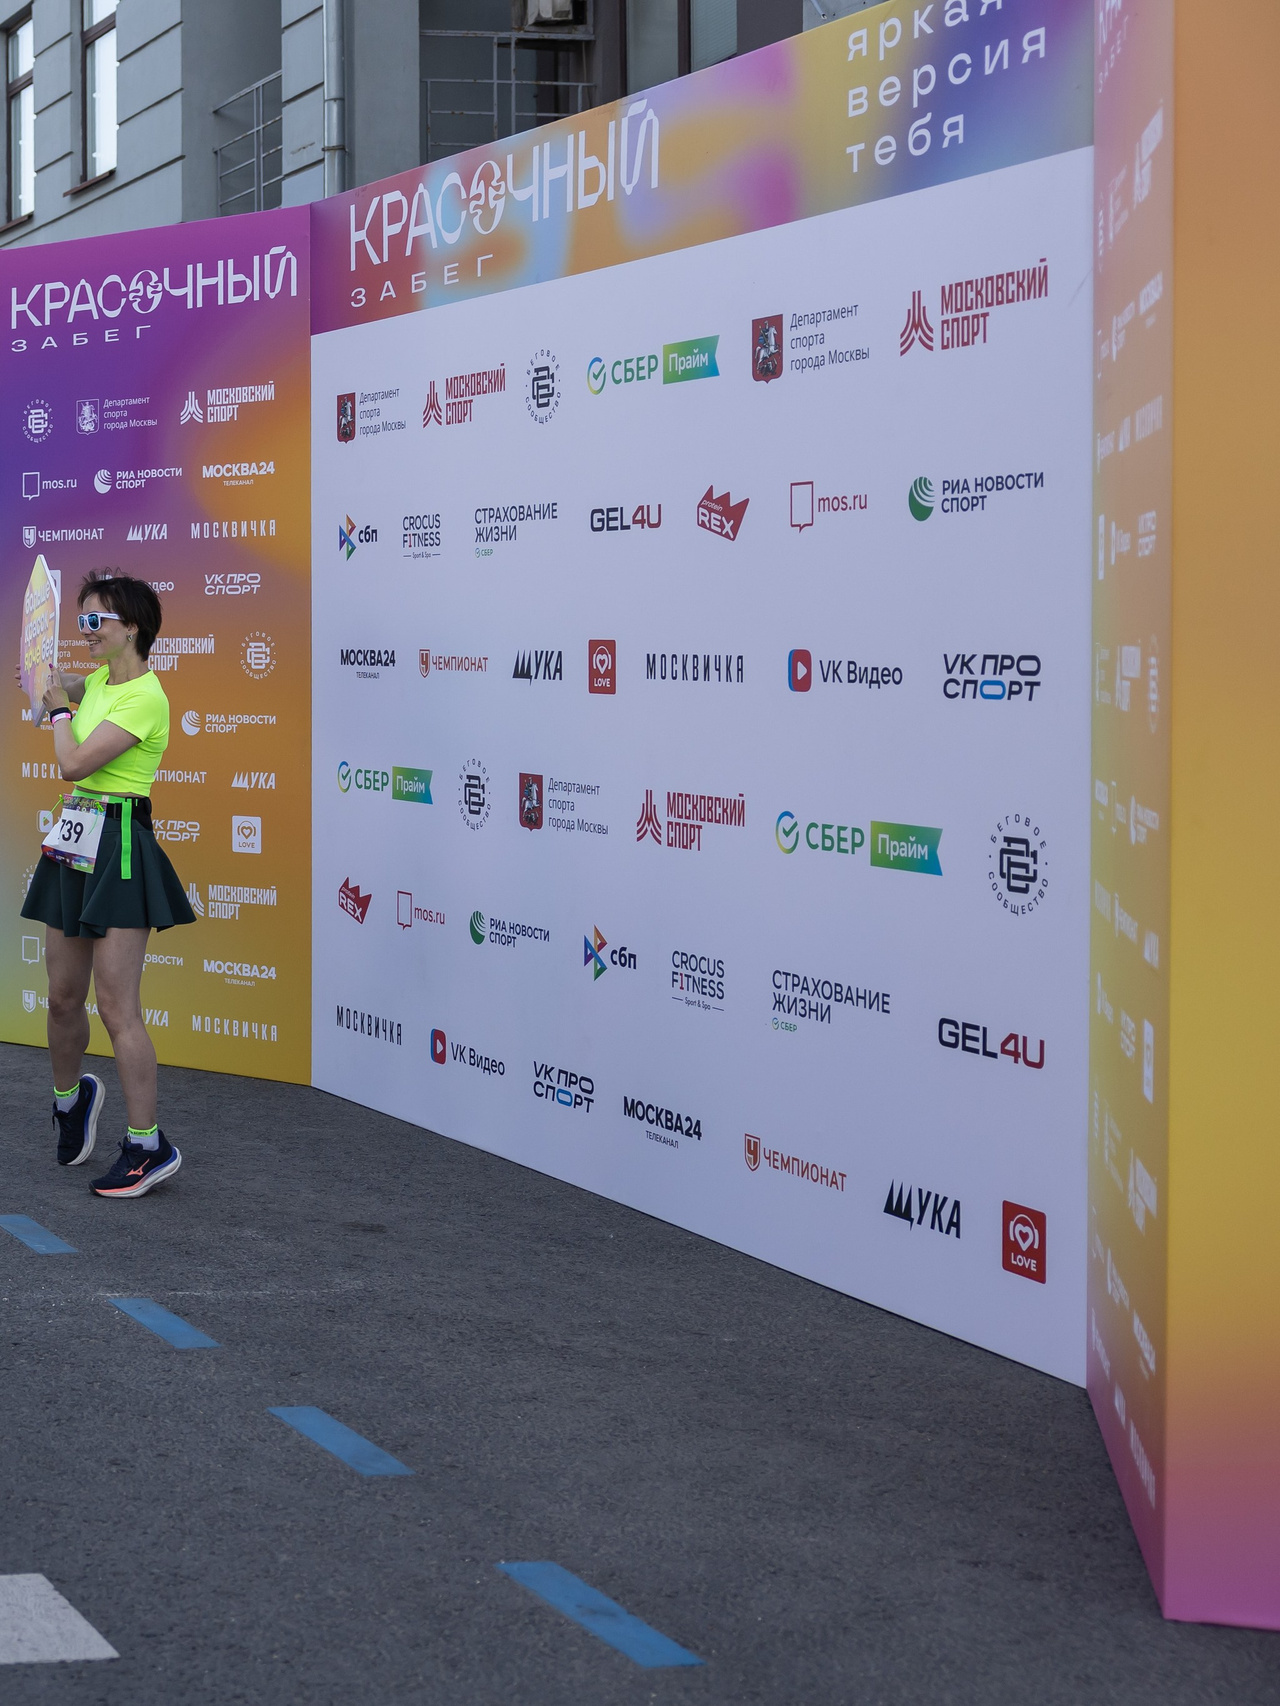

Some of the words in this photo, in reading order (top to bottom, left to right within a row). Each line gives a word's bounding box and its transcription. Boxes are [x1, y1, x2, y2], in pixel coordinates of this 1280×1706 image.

[847, 27, 1047, 118] версия
[845, 113, 965, 173] тебя
[350, 99, 659, 271] КРАСОЧНЫЙ
[11, 246, 297, 329] КРАСОЧНЫЙ
[351, 253, 493, 308] ЗАБЕГ
[941, 257, 1048, 316] МОСКОВСКИЙ
[790, 304, 859, 331] Департамент
[11, 325, 151, 352] ЗАБЕГ
[790, 331, 825, 351] спорта
[941, 312, 990, 350] СПОРТ
[526, 349, 560, 375] БЕГОВОЕ
[611, 354, 658, 385] СБЕР
[668, 349, 709, 376] Прайм
[790, 355, 825, 373] города
[828, 347, 870, 365] Москвы
[445, 363, 506, 397] МОСКОВСКИЙ
[103, 396, 150, 409] Департамент
[207, 380, 275, 406] МОСКОВСКИЙ
[359, 387, 400, 406] Департамент
[23, 399, 53, 419] БЕГОВОЕ
[103, 410, 128, 421] спорта
[207, 405, 239, 423] СПОРТ
[359, 406, 381, 420] спорта
[445, 399, 474, 426] СПОРТ
[525, 391, 562, 425] СООБЩЕСТВО
[22, 424, 54, 443] СООБЩЕСТВО
[103, 421, 127, 431] города
[129, 418, 158, 428] Москвы
[359, 423, 380, 437] города
[381, 419, 407, 432] Москвы
[116, 470, 135, 479] РИА
[137, 467, 182, 478] НОВОСТИ
[202, 461, 275, 478] МОСКВА24
[42, 478, 77, 489] mos.ru
[116, 479, 146, 489] СПОРТ
[942, 478, 970, 495] РИА
[974, 471, 1044, 493] НОВОСТИ
[700, 498, 723, 512] protein
[818, 492, 868, 512] mos.ru
[941, 495, 987, 513] СПОРТ
[402, 513, 441, 531] CROCUS
[474, 502, 558, 524] СТРАХОВАНИЕ
[590, 503, 662, 532] GEL4U
[126, 523, 168, 543] ЩУКА
[191, 519, 276, 539] МОСКВИЧКА
[474, 524, 517, 543] ЖИЗНИ
[698, 510, 734, 537] REX
[38, 528, 104, 542] ЧЕМПИОНАТ
[358, 525, 378, 544] сбп
[481, 548, 493, 557] СБЕР
[148, 580, 175, 593] део
[204, 574, 225, 584] VK
[226, 573, 261, 584] ПРО
[204, 585, 261, 595] СПОРТ
[58, 640, 90, 649] партамен
[241, 631, 275, 649] БЕГОВОЕ
[73, 661, 100, 669] Москвы
[148, 655, 179, 671] СПОРТ
[340, 649, 395, 667] МОСКВА24
[432, 655, 488, 672] ЧЕМПИОНАТ
[512, 649, 563, 686] ЩУКА
[646, 653, 744, 683] МОСКВИЧКА
[943, 654, 977, 675] VK
[981, 654, 1041, 677] ПРО
[240, 659, 277, 680] СООБЩЕСТВО
[356, 671, 380, 680] ТЕЛЕКАНАЛ
[820, 660, 843, 683] VK
[847, 661, 903, 689] Видео
[594, 677, 610, 688] LOVE
[943, 679, 1041, 701] СПОРТ
[205, 714, 226, 724] РИА
[229, 714, 276, 725] НОВОСТИ
[205, 724, 238, 733] СПОРТ
[22, 762, 63, 779] МОСКВ
[154, 770, 207, 784] МПИОНАТ
[459, 758, 490, 784] БЕГОВОЕ
[231, 771, 276, 791] ЩУКА
[355, 768, 389, 792] СБЕР
[396, 774, 425, 796] Прайм
[548, 777, 600, 796] Департамент
[458, 799, 492, 832] СООБЩЕСТВО
[548, 798, 575, 813] спорта
[667, 791, 745, 827] МОСКОВСКИЙ
[167, 820, 200, 832] ПРО
[548, 817, 575, 832] города
[577, 819, 609, 835] Москвы
[990, 813, 1047, 849] БЕГОВОЕ
[155, 831, 200, 842] ПОРТ
[239, 841, 255, 849] LOVE
[667, 822, 703, 852] СПОРТ
[806, 821, 865, 855] СБЕР
[878, 833, 928, 861] Прайм
[208, 884, 277, 906] МОСКОВСКИЙ
[988, 870, 1049, 916] СООБЩЕСТВО
[208, 902, 240, 920] СПОРТ
[339, 892, 364, 922] REX
[414, 906, 445, 925] mos.ru
[489, 918, 507, 933] РИА
[509, 922, 550, 942] НОВОСТИ
[489, 932, 516, 948] СПОРТ
[144, 954, 183, 967] ОВОСТИ
[610, 947, 637, 970] сбп
[671, 951, 724, 978] CROCUS
[203, 959, 277, 980] МОСКВА24
[224, 978, 255, 987] ТЕЛЕКАНАЛ
[772, 969, 891, 1014] СТРАХОВАНИЕ
[772, 991, 832, 1024] ЖИЗНИ
[144, 1009, 169, 1027] УКА
[336, 1005, 403, 1046] МОСКВИЧКА
[780, 1021, 798, 1033] СБЕР
[192, 1015, 277, 1042] МОСКВИЧКА
[938, 1017, 1045, 1070] GEL4U
[451, 1042, 467, 1064] VK
[469, 1047, 505, 1076] Видео
[533, 1061, 554, 1082] VK
[557, 1069, 595, 1095] ПРО
[533, 1080, 594, 1114] СПОРТ
[623, 1096, 702, 1141] МОСКВА24
[645, 1130, 679, 1149] ТЕЛЕКАНАЛ
[763, 1147, 847, 1192] ЧЕМПИОНАТ
[883, 1178, 961, 1239] ЩУКА
[1011, 1252, 1037, 1273] LOVE
